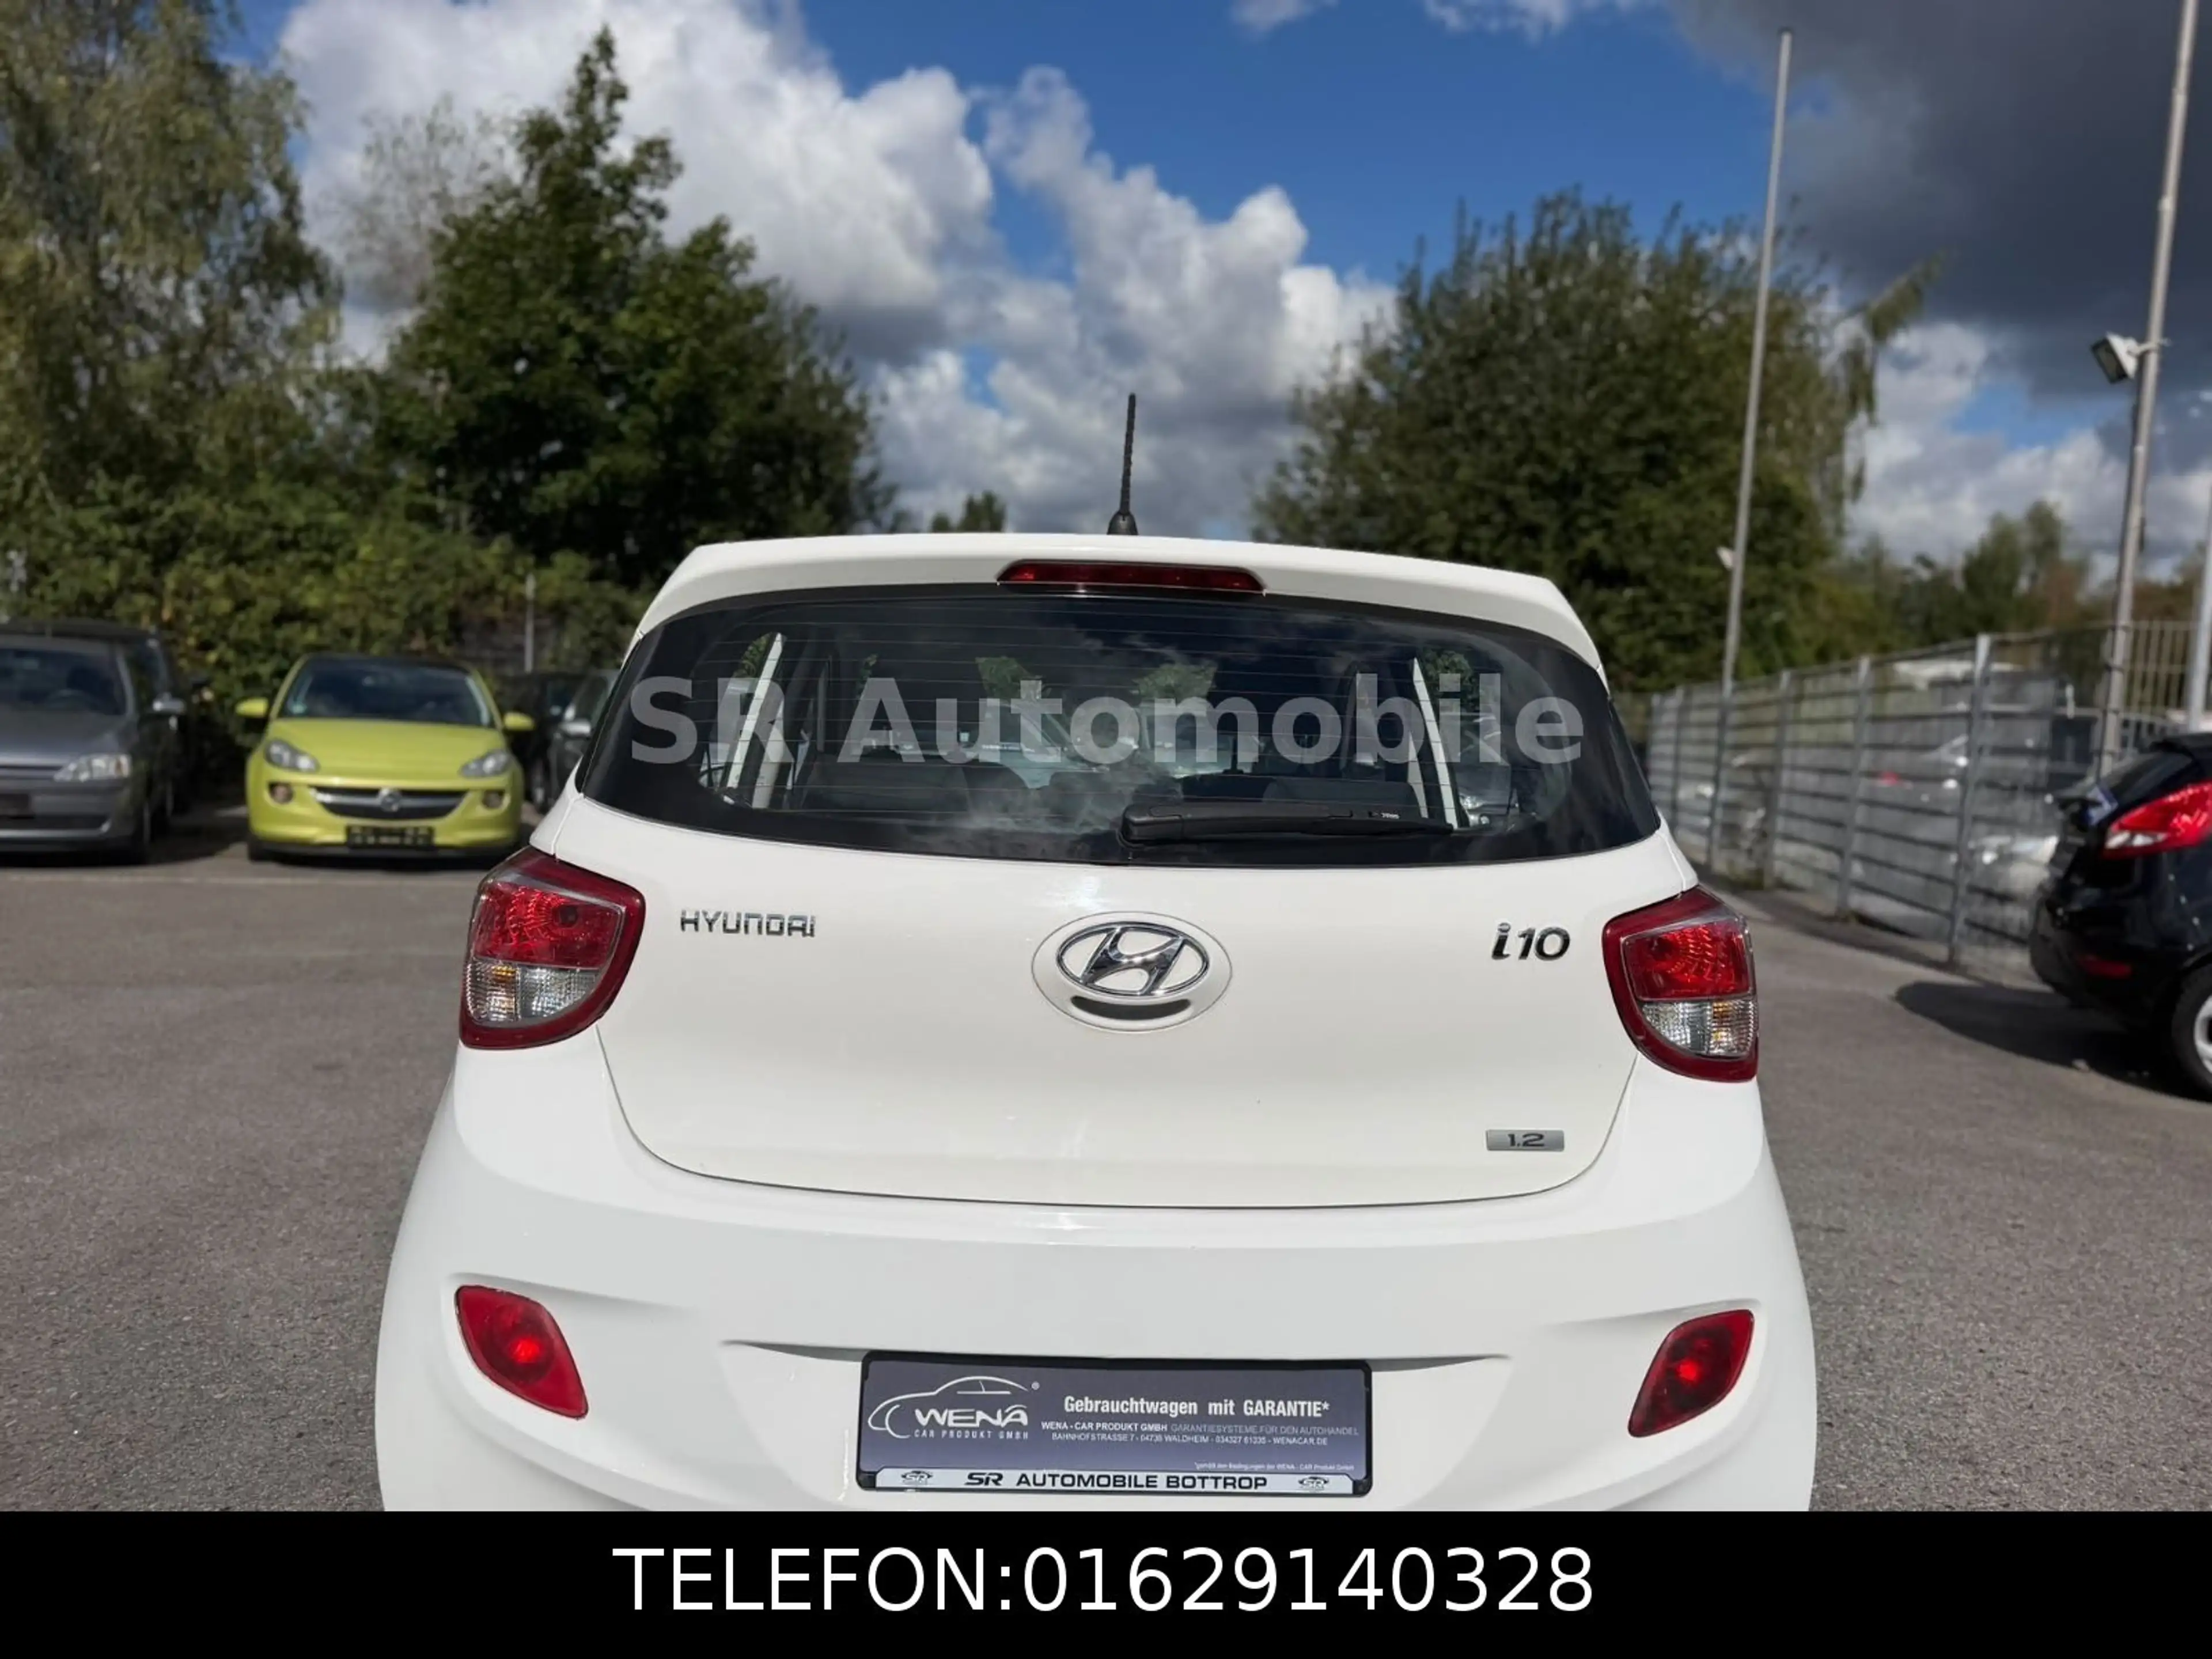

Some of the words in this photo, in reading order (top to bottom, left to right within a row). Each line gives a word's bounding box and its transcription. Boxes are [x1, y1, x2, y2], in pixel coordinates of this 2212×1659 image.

[680, 910, 816, 938] HYUNDAI
[1491, 922, 1570, 961] i10
[1508, 1132, 1544, 1147] 1.2
[1064, 1396, 1198, 1416] Gebrauchtwagen
[1208, 1400, 1234, 1416] mit
[914, 1406, 1028, 1427] WENA
[914, 1429, 934, 1438] CAR
[941, 1430, 993, 1439] PRODUKT
[998, 1431, 1029, 1440] GMBH
[1041, 1421, 1068, 1430] WENA
[1074, 1422, 1093, 1430] CAR
[1096, 1422, 1138, 1431] PRODUKT
[1141, 1423, 1168, 1431] GMBH
[1052, 1433, 1128, 1441] BAHNHOFSTRASSE
[1164, 1434, 1209, 1443] WALDHEIM
[965, 1472, 1003, 1486] SR
[1016, 1473, 1158, 1488] AUTOMOBILE
[1166, 1476, 1267, 1490] BOTTROP
